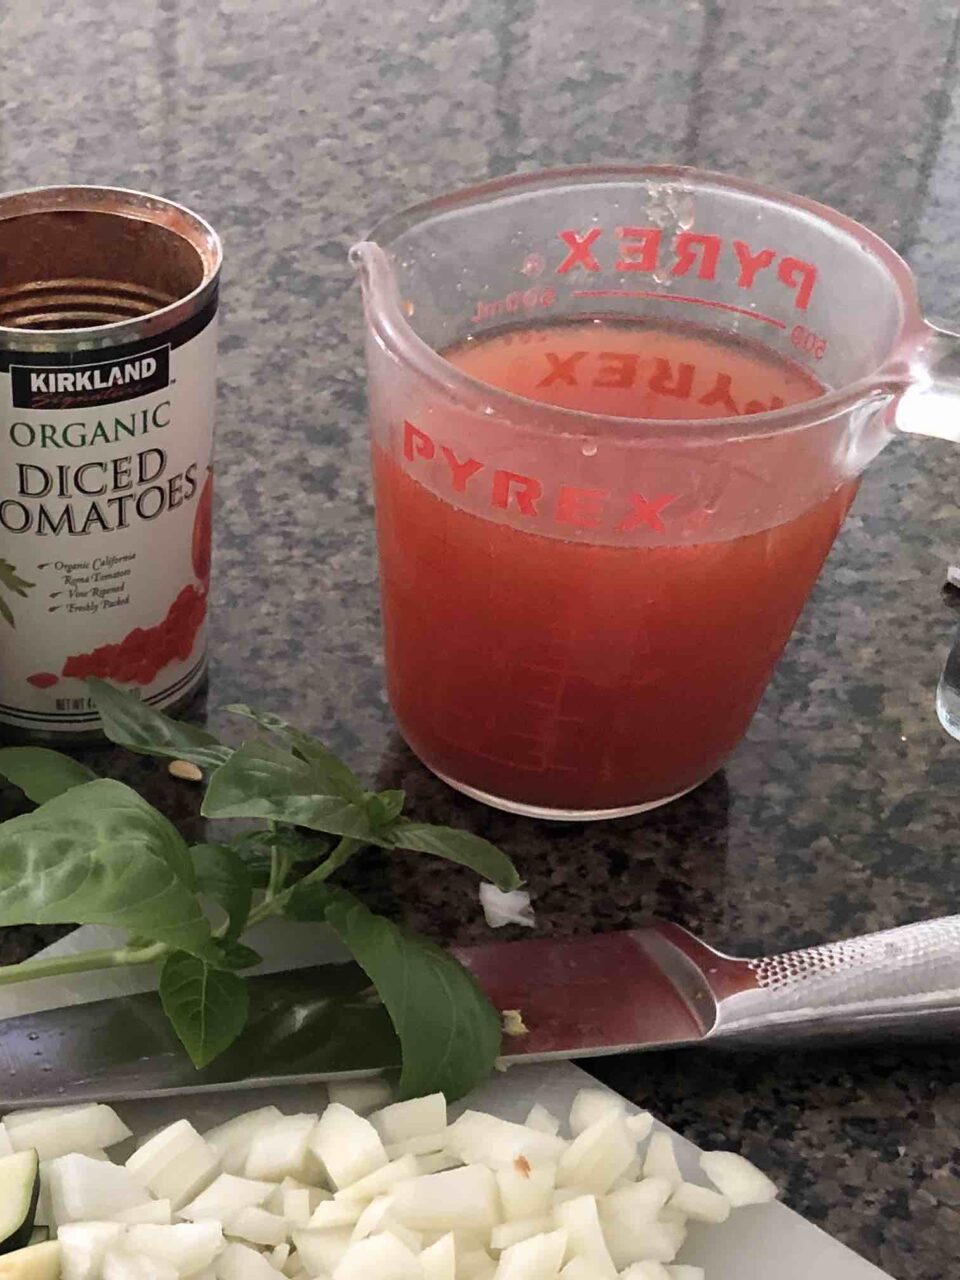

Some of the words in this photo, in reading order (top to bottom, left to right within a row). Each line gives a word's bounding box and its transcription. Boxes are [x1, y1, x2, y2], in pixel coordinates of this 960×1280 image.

[30, 357, 157, 393] KIRKLAND
[9, 400, 171, 449] ORGANIC
[16, 448, 167, 498] DICED
[403, 419, 680, 534] PYREX
[54, 561, 89, 573] Organic
[92, 553, 136, 571] California
